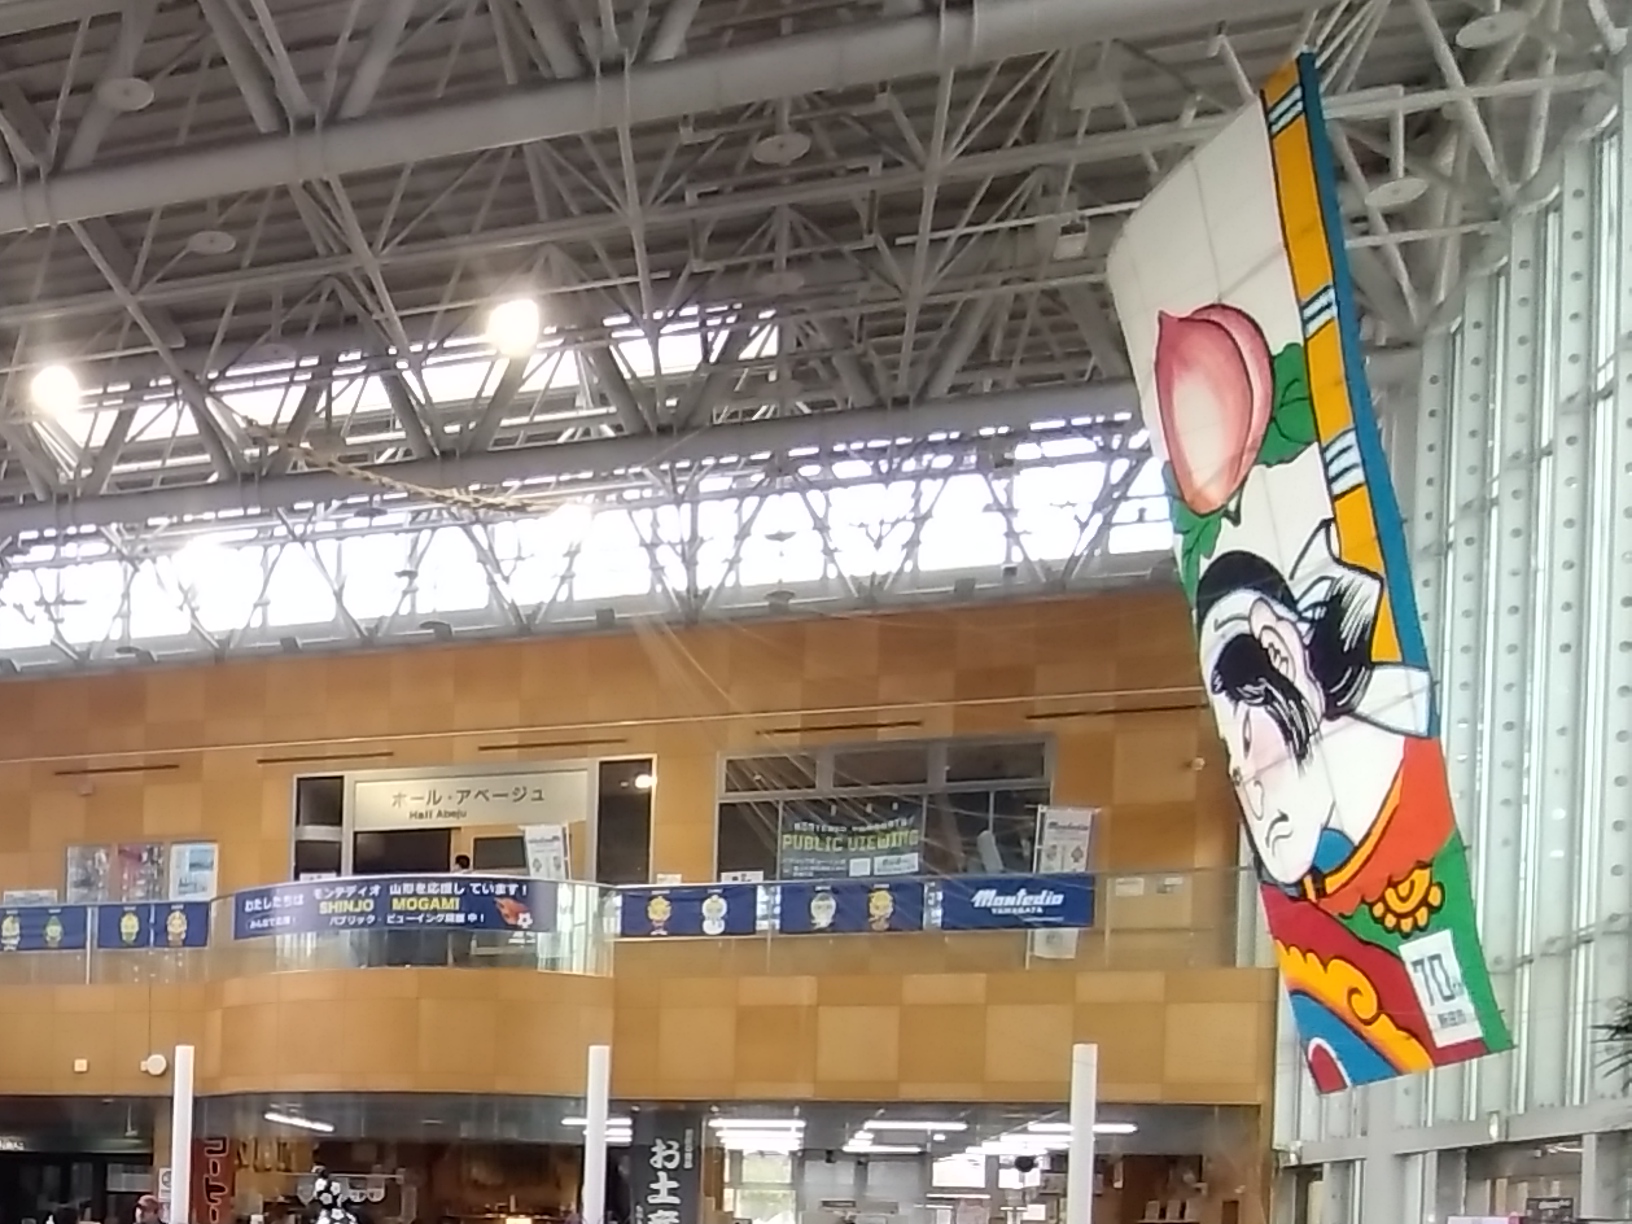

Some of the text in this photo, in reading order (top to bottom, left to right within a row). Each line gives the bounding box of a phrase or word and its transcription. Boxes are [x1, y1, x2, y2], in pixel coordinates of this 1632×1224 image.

[391, 786, 545, 808] ホール・アベージュ
[409, 808, 467, 820] Hall Abeju
[782, 829, 920, 852] PUBLIC VIEWING
[319, 896, 460, 914] SHINJO MOGAMI
[970, 887, 1065, 908] Montedio
[203, 1136, 228, 1224] コーヒー
